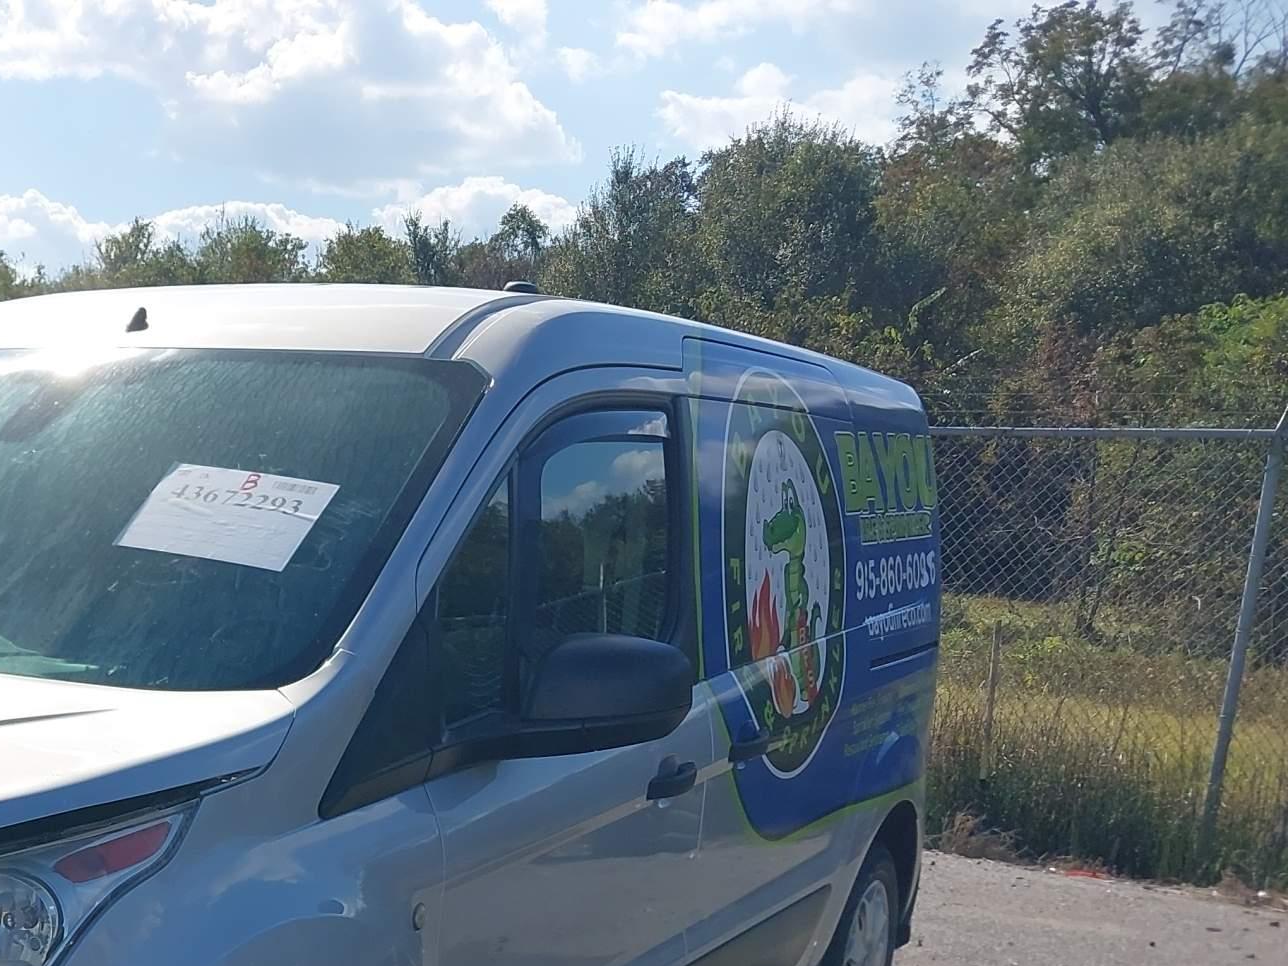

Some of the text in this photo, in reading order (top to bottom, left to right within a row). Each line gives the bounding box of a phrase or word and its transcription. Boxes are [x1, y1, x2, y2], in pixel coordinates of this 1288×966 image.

[240, 473, 262, 491] B
[834, 431, 938, 515] BAYOU
[171, 484, 304, 515] 43672293
